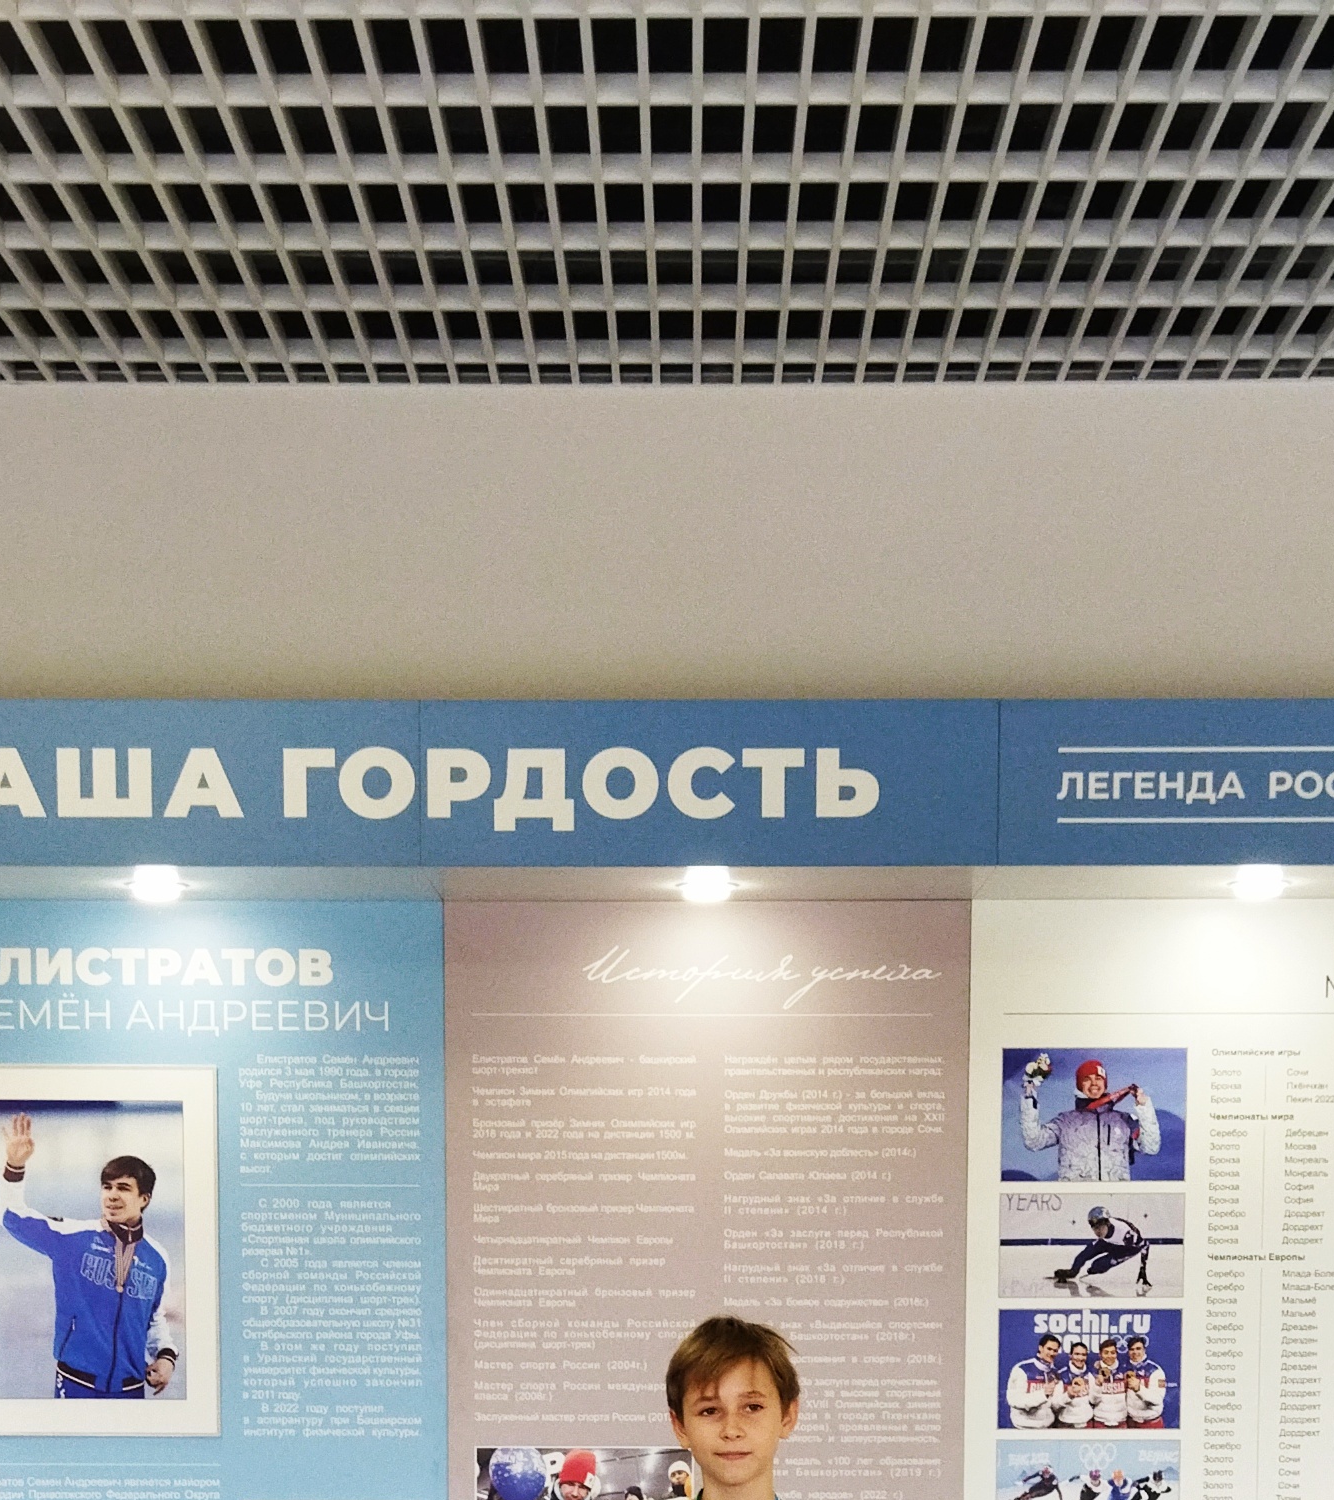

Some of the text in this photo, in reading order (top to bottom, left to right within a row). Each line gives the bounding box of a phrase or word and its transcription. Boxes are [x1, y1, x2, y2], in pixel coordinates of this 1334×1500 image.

[284, 745, 880, 831] ГОРДОСТЬ
[1057, 770, 1245, 805] ЛЕГЕНДА
[583, 945, 800, 1002] История
[126, 999, 389, 1037] АНДРЕЕВИЧ
[1034, 1309, 1151, 1333] sochi.ru
